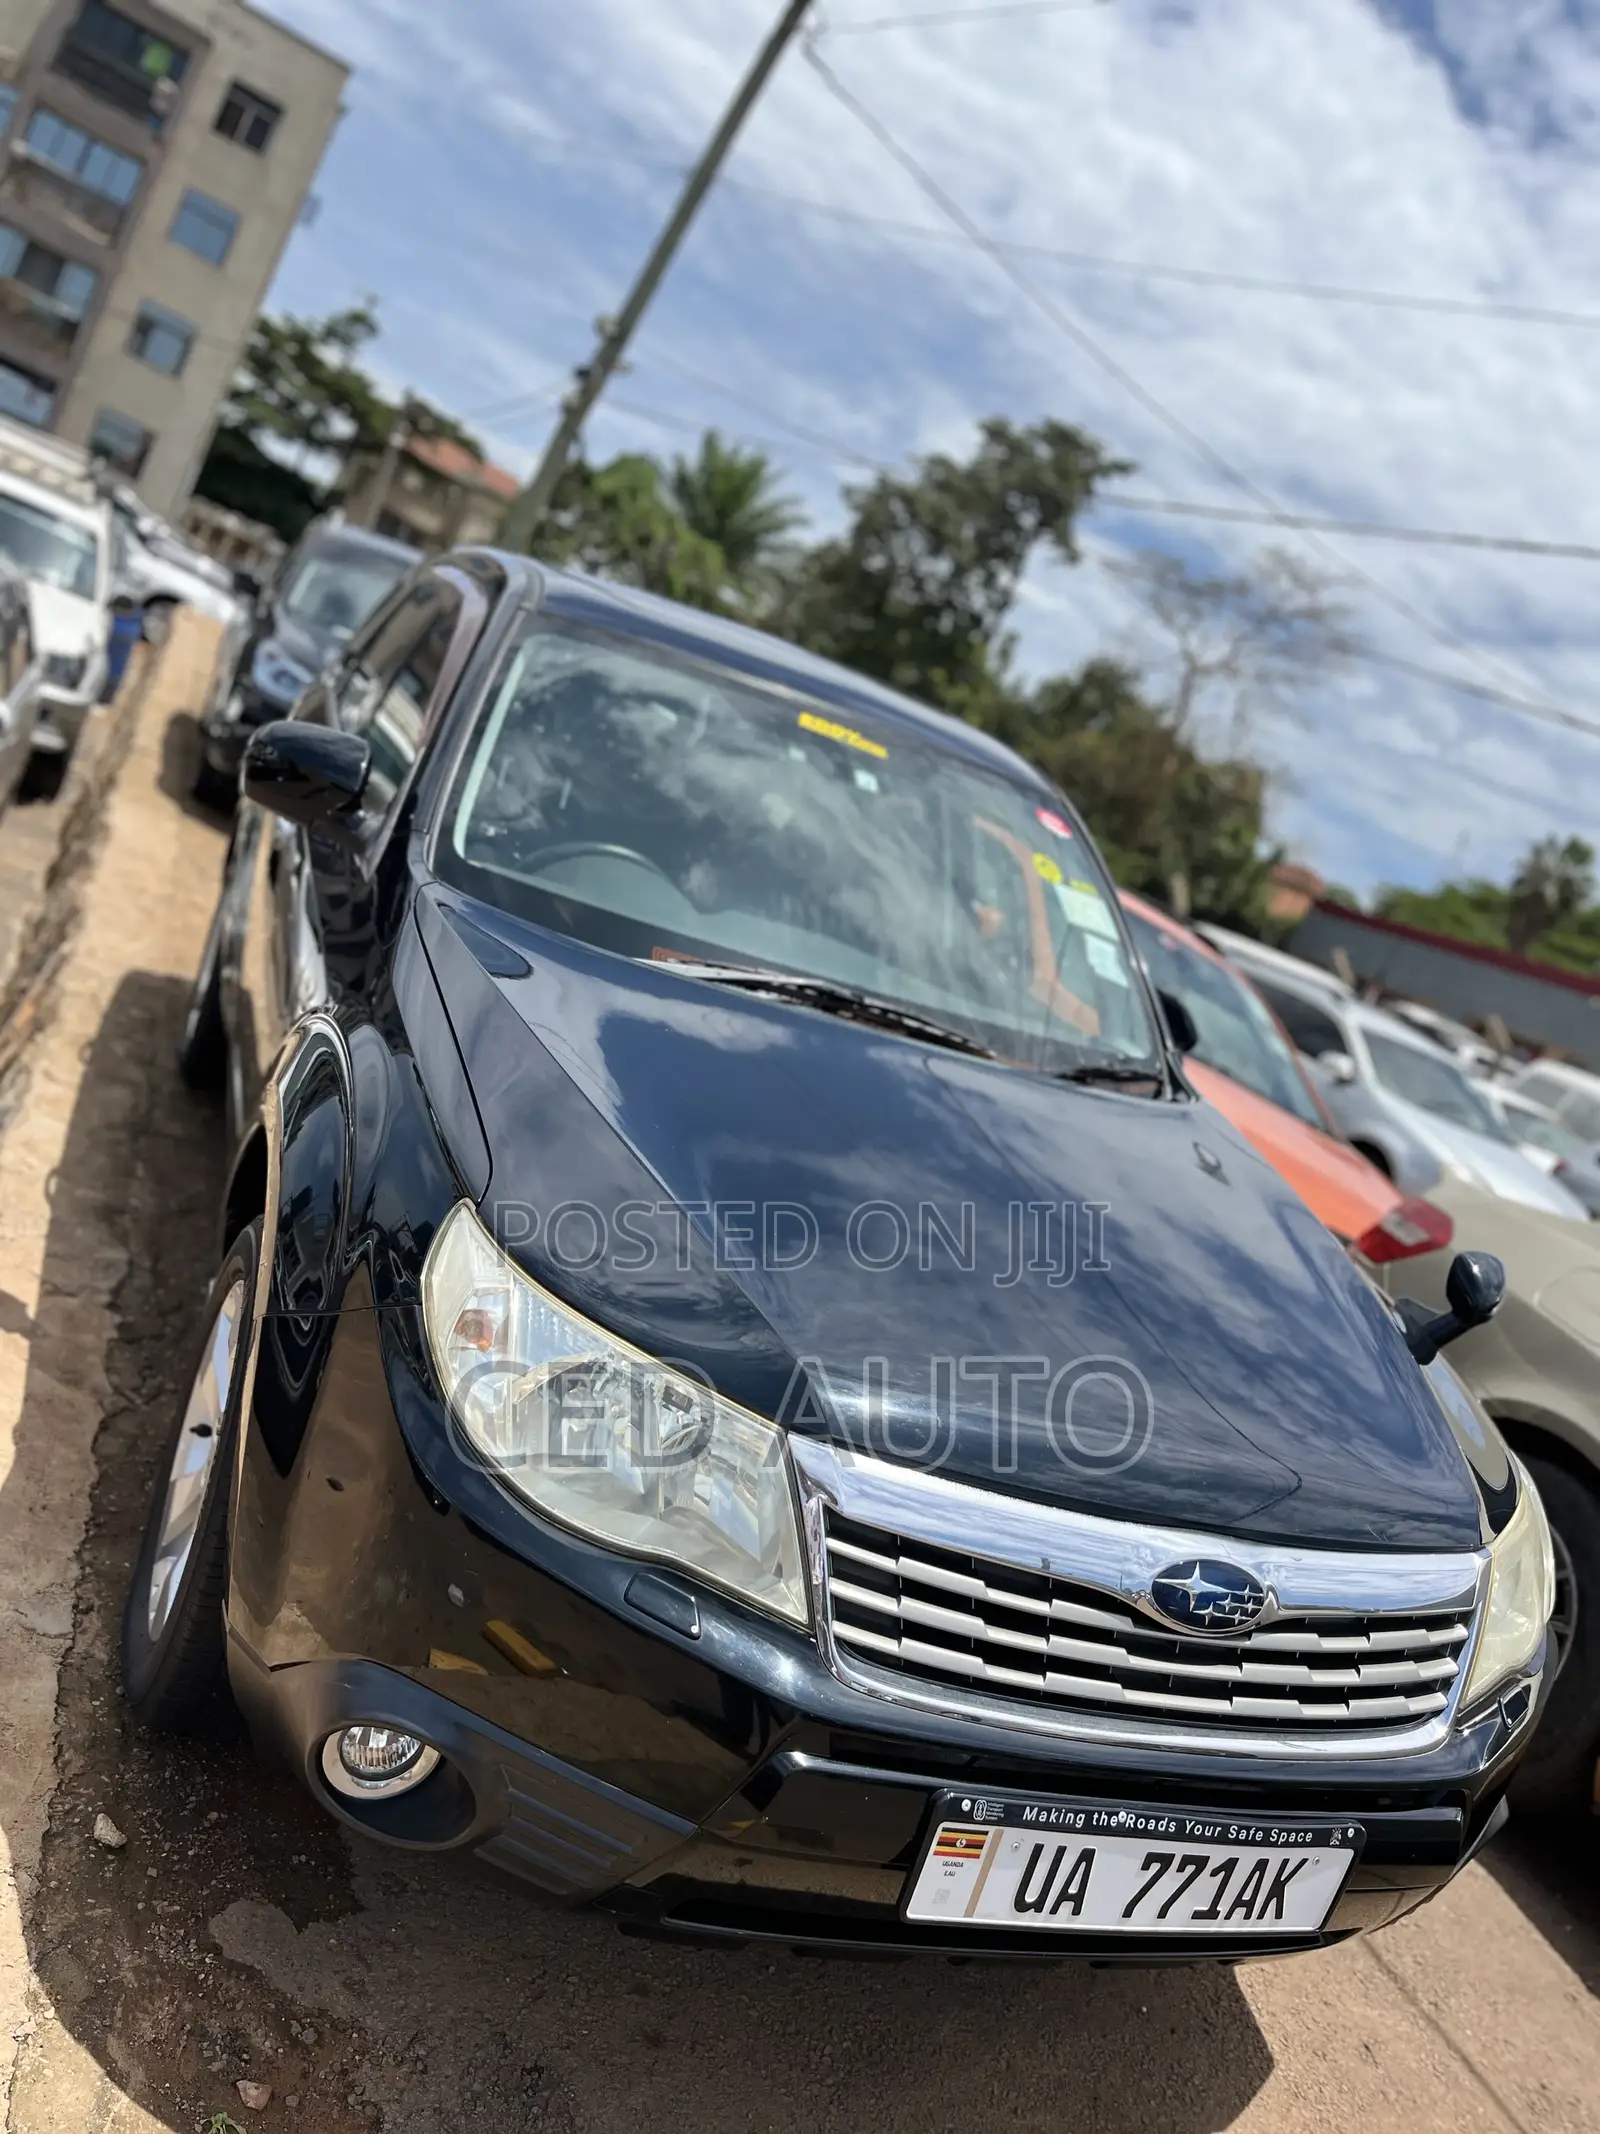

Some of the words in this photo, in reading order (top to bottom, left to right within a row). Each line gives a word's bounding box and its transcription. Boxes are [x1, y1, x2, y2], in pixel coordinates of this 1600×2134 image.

[1022, 1806, 1085, 1828] Making
[1092, 1811, 1118, 1826] the
[1125, 1813, 1177, 1832] Roads
[1184, 1819, 1222, 1837] Your
[1228, 1825, 1263, 1841] Safe
[1269, 1828, 1313, 1845] Space
[1012, 1842, 1097, 1916] UA
[1121, 1852, 1309, 1920] 771AK
